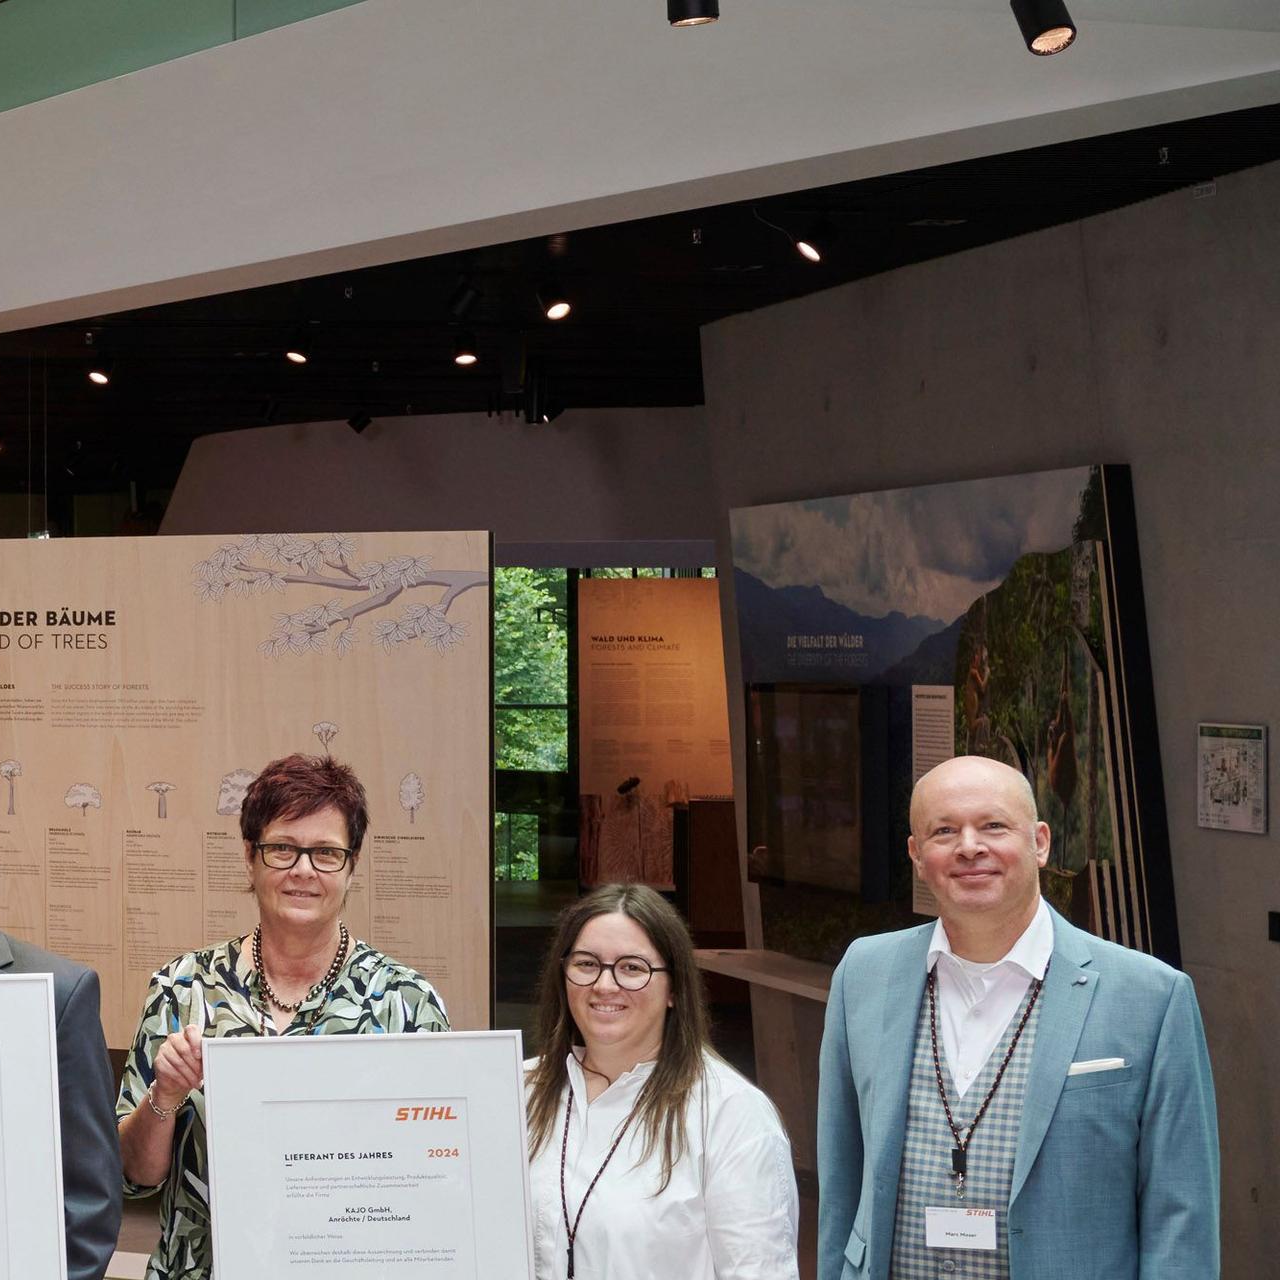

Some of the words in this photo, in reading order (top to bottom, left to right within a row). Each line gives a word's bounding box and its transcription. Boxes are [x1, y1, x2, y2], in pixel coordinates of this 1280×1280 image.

[0, 611, 37, 626] DER
[46, 608, 115, 626] BÄUME
[18, 634, 43, 649] OF
[51, 634, 107, 649] TREES
[395, 1107, 457, 1121] STIHL
[285, 1153, 334, 1161] LIEFERANT
[338, 1152, 355, 1160] DES
[428, 1149, 459, 1158] 2024
